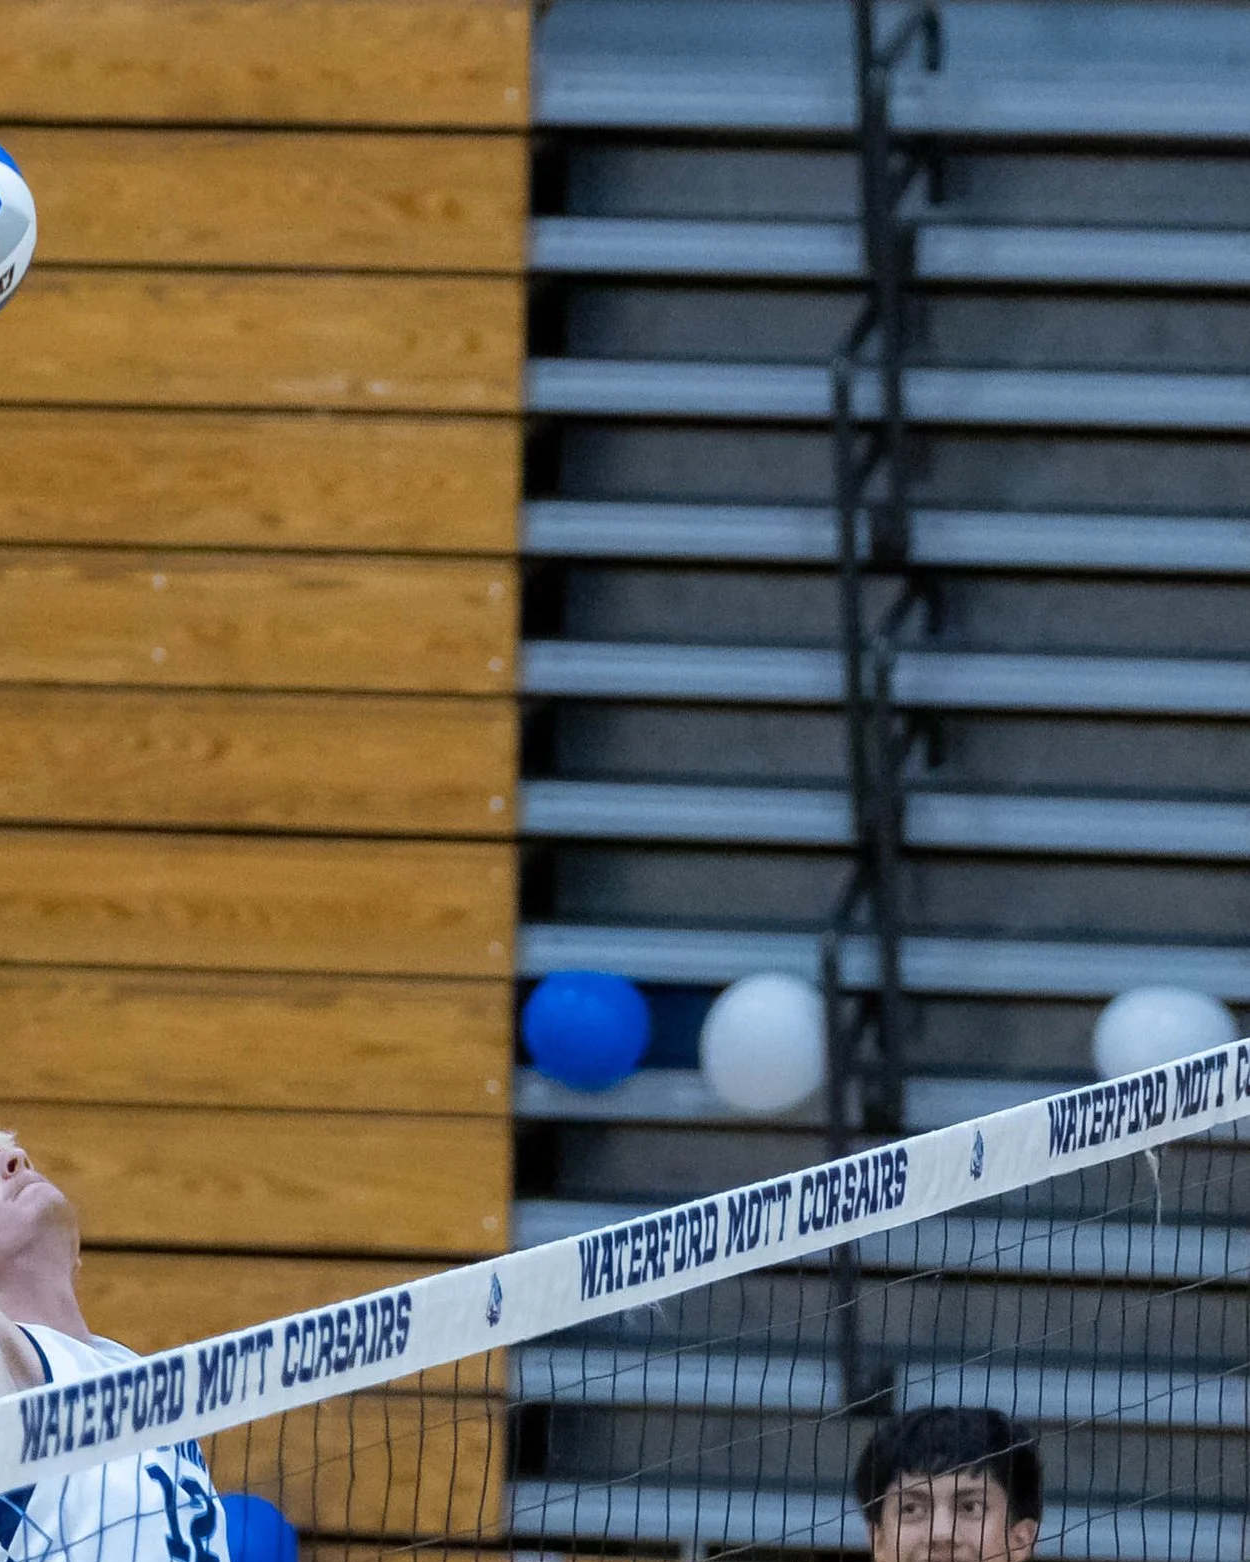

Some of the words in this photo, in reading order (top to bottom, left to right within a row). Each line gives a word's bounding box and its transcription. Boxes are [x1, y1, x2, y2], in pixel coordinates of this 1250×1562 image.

[1048, 1070, 1168, 1158] WATERFORD
[1173, 1052, 1229, 1121] MOTT
[578, 1196, 717, 1301] WATERFORD
[724, 1180, 792, 1253] MOTT
[798, 1147, 908, 1235] CORSAIRS
[20, 1355, 185, 1463] WATERFORD
[196, 1329, 273, 1416] MOTT
[281, 1291, 412, 1388] CORSAIRS
